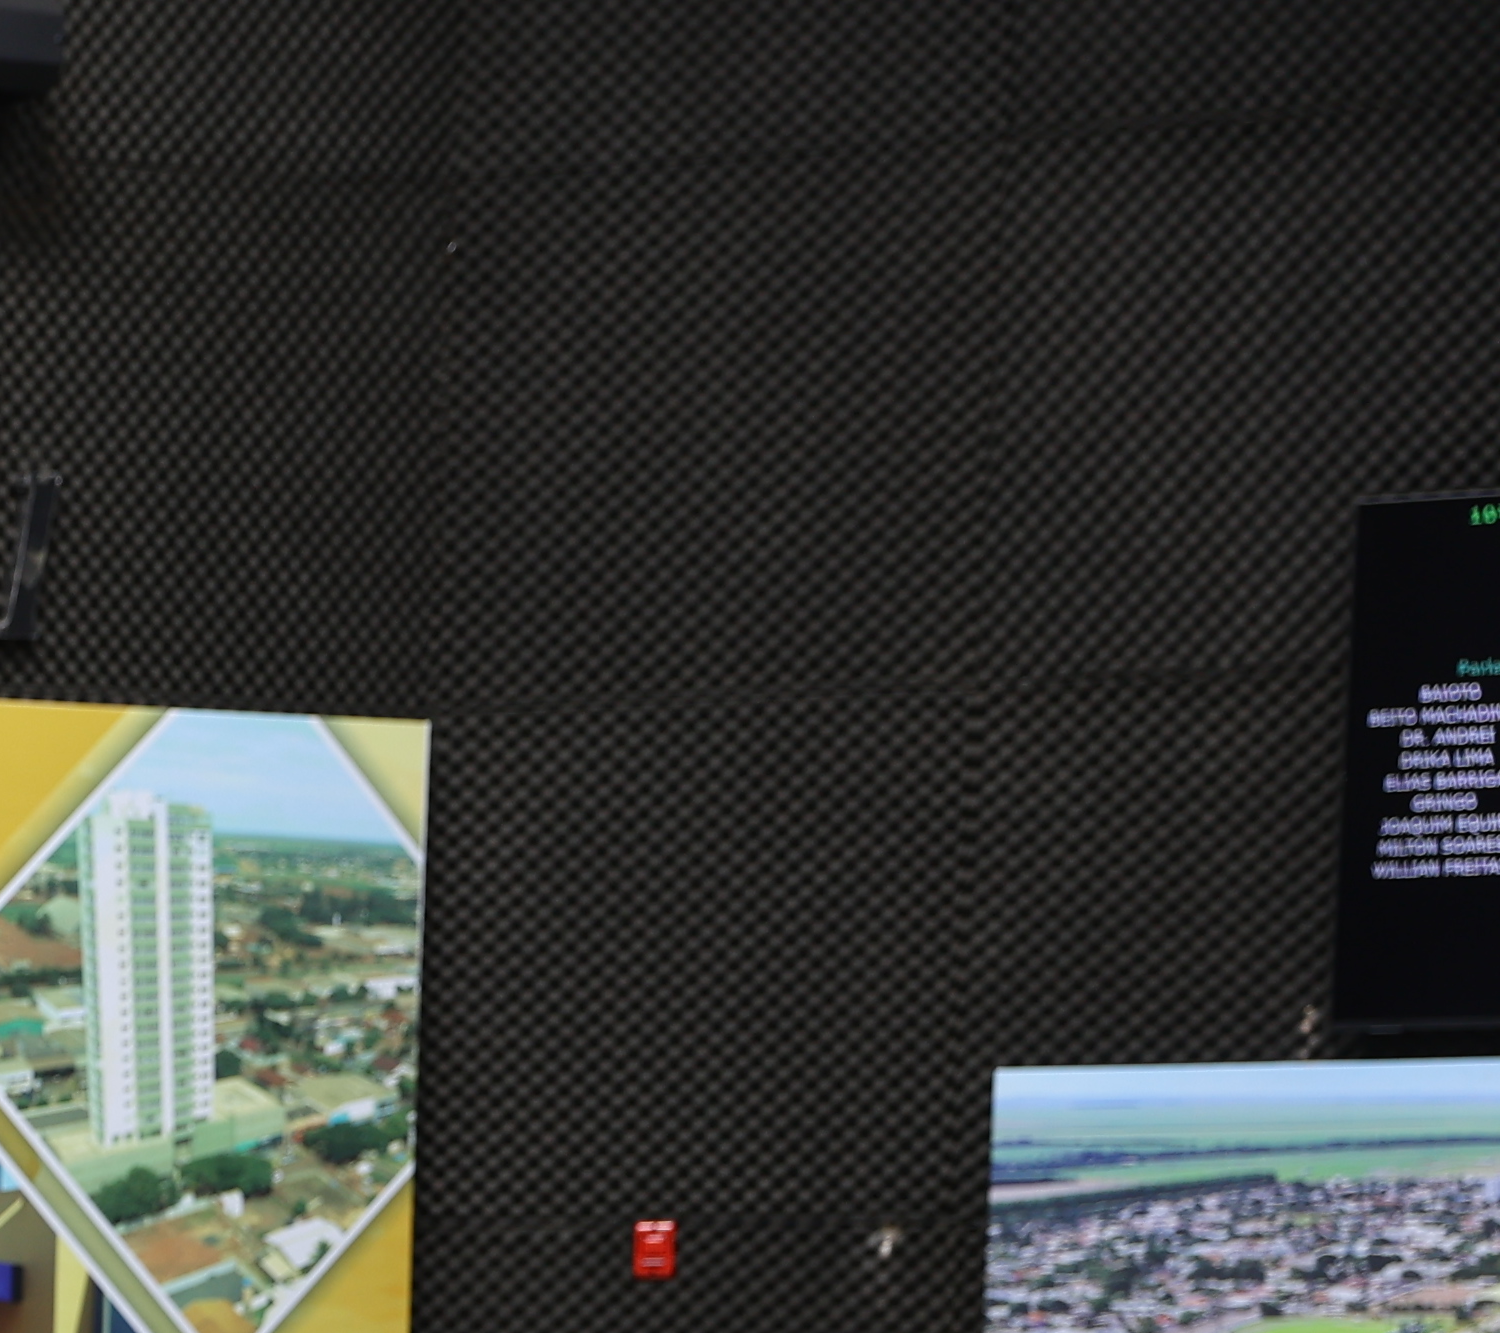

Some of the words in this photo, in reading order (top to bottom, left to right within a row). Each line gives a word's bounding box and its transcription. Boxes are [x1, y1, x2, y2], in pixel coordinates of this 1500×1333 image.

[1469, 503, 1500, 527] 10
[1418, 682, 1482, 704] BAIOTO
[1431, 724, 1496, 747] ANDREI
[1453, 746, 1496, 768] LIMA
[1382, 771, 1432, 793] ELIAS
[1409, 791, 1479, 813] GRINGO
[1376, 836, 1439, 858] MILTON
